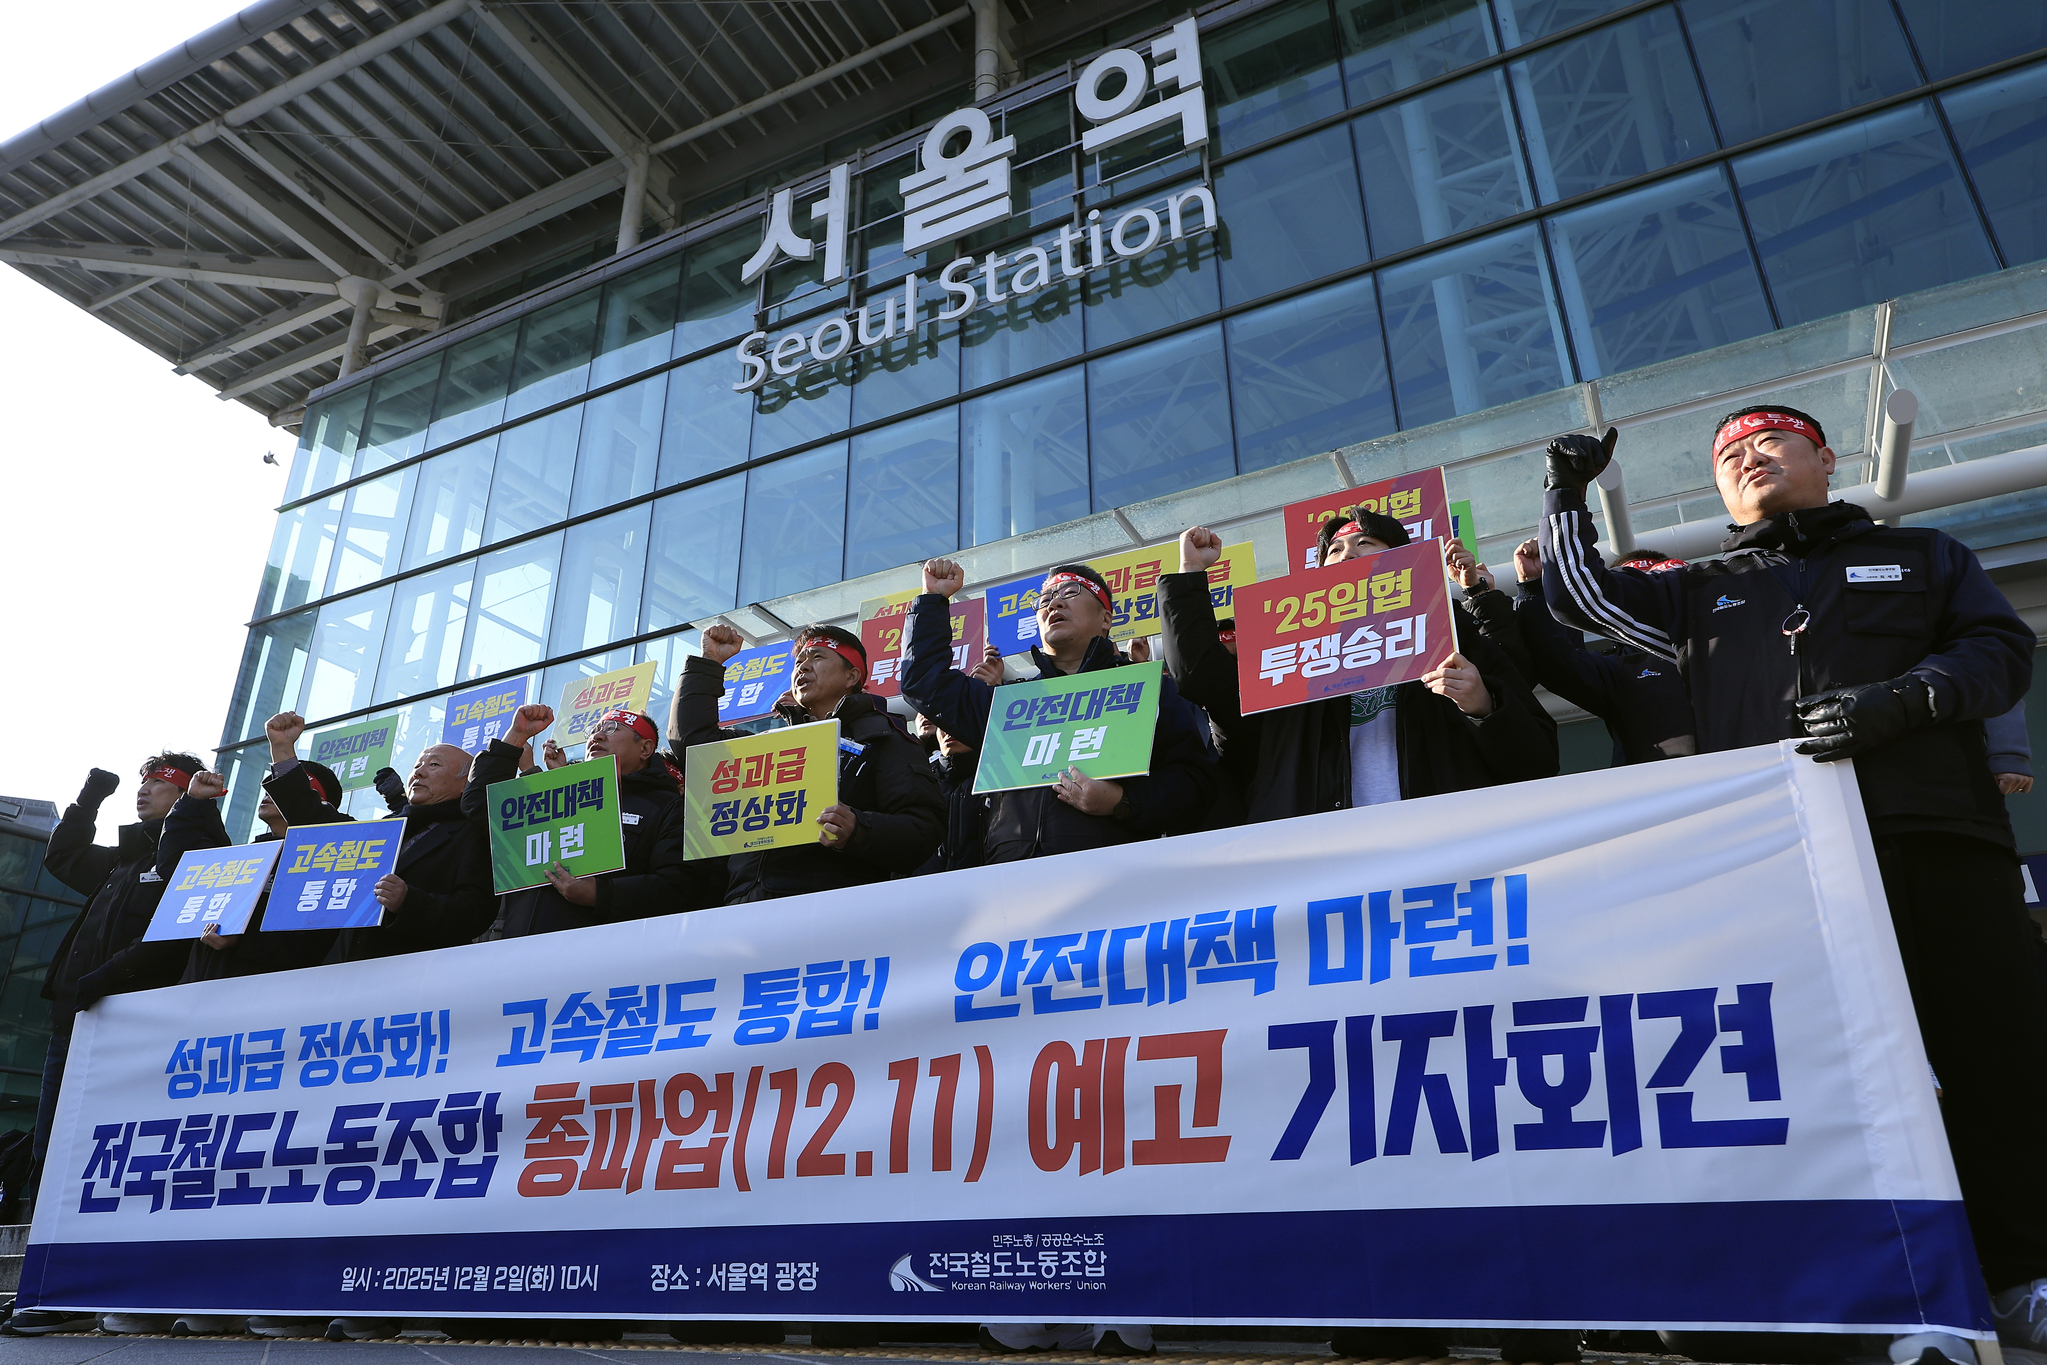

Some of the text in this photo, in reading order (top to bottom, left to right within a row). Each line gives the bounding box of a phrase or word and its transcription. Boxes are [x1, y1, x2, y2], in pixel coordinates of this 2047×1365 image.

[741, 15, 1209, 286] 서울역
[732, 184, 1217, 393] Seoul Station
[1099, 559, 1163, 594] 과급
[1263, 567, 1413, 635] '25임협
[1259, 613, 1428, 686] 투쟁승리
[724, 653, 789, 683] 속철도
[450, 691, 518, 727] 고속철도
[575, 675, 637, 710] 성과급
[1002, 681, 1146, 732] 안전대책
[317, 727, 389, 762] 안전대책
[710, 746, 808, 795] 성과급
[501, 776, 605, 832] 안전대책
[709, 788, 808, 837] 정상화
[287, 839, 387, 874] 고속철도
[174, 857, 265, 892] 고속철도
[164, 873, 1530, 1100] 성과급 정상화! 고속철도 통합! 안전대책 마련!
[78, 981, 1790, 1215] 전국철도노동조합 총파업(12.11) 예고 기자회견
[992, 1233, 1034, 1248] 민주노총
[1041, 1232, 1105, 1248] 공공운수노조
[382, 1266, 450, 1292] 2025년
[453, 1265, 490, 1292] 12월
[493, 1264, 555, 1292] 2일(화)
[560, 1264, 599, 1292] 10시
[706, 1262, 768, 1292] 서울역
[775, 1261, 820, 1291] 광장
[929, 1249, 1108, 1279] 전국철도노동조합
[951, 1281, 986, 1291] Korean
[989, 1280, 1026, 1293] Railway
[1076, 1280, 1106, 1290] Union
